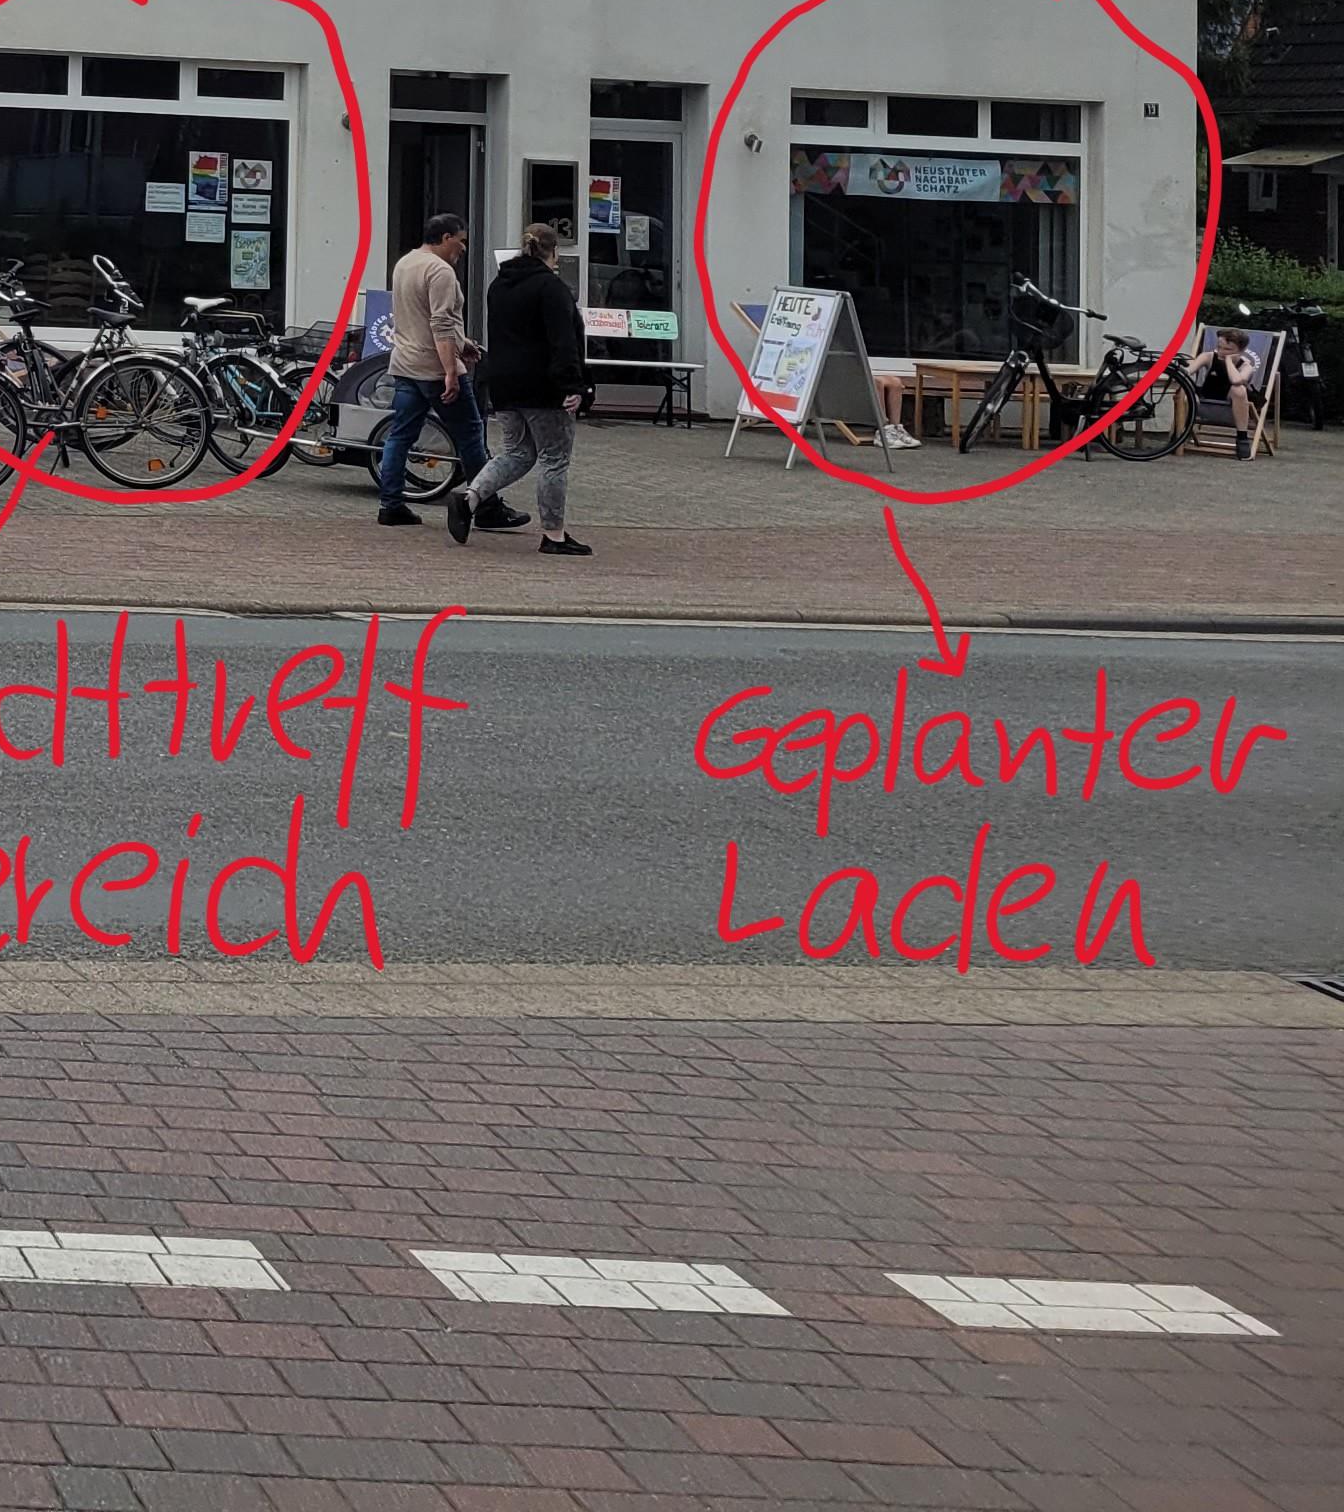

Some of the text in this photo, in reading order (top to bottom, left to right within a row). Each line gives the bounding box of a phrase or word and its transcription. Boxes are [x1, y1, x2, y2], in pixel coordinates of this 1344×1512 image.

[914, 165, 988, 177] NEUSTÄDTER
[915, 174, 974, 186] NACHBAR-
[916, 183, 960, 194] SCHATZ
[776, 295, 815, 316] HEUTE
[634, 319, 670, 332] Toleranz
